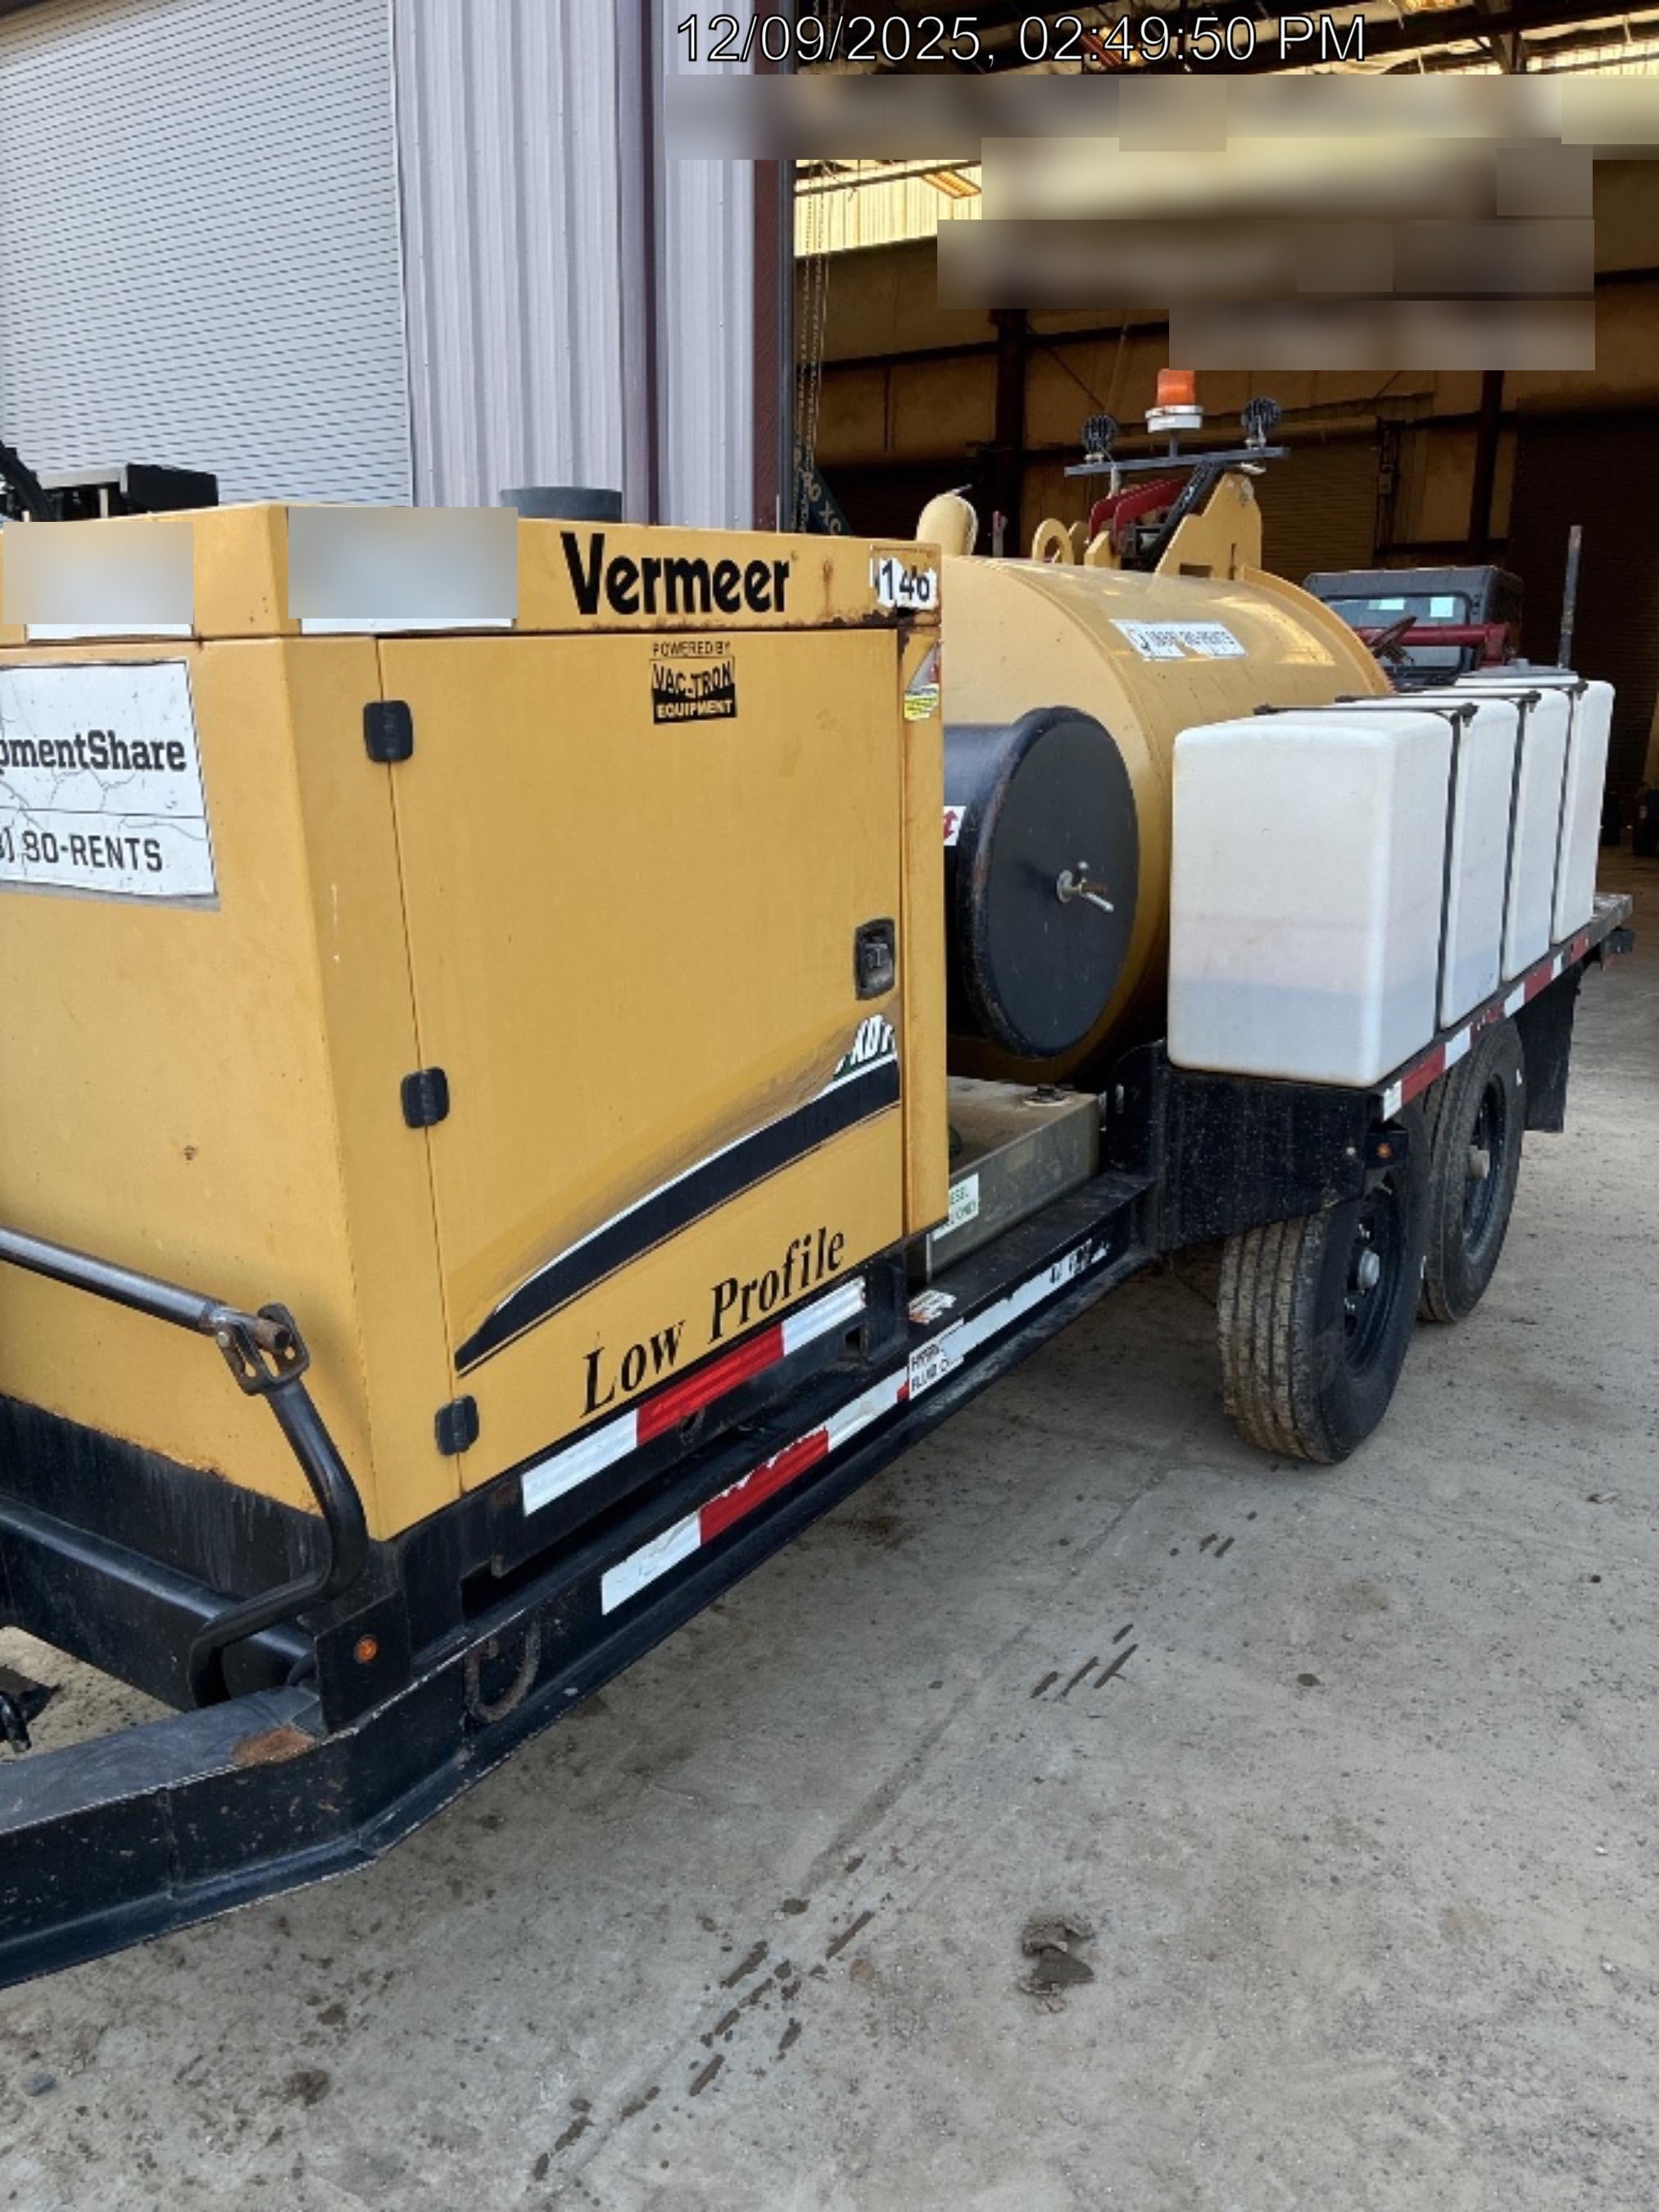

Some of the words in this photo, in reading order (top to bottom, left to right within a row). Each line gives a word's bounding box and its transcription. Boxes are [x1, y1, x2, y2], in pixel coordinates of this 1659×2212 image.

[561, 531, 790, 615] Vermeer
[653, 641, 713, 656] POWERED
[715, 641, 731, 655] BY
[657, 700, 733, 718] EQUIPMENT
[580, 1319, 686, 1418] Low
[707, 1226, 845, 1344] Profile
